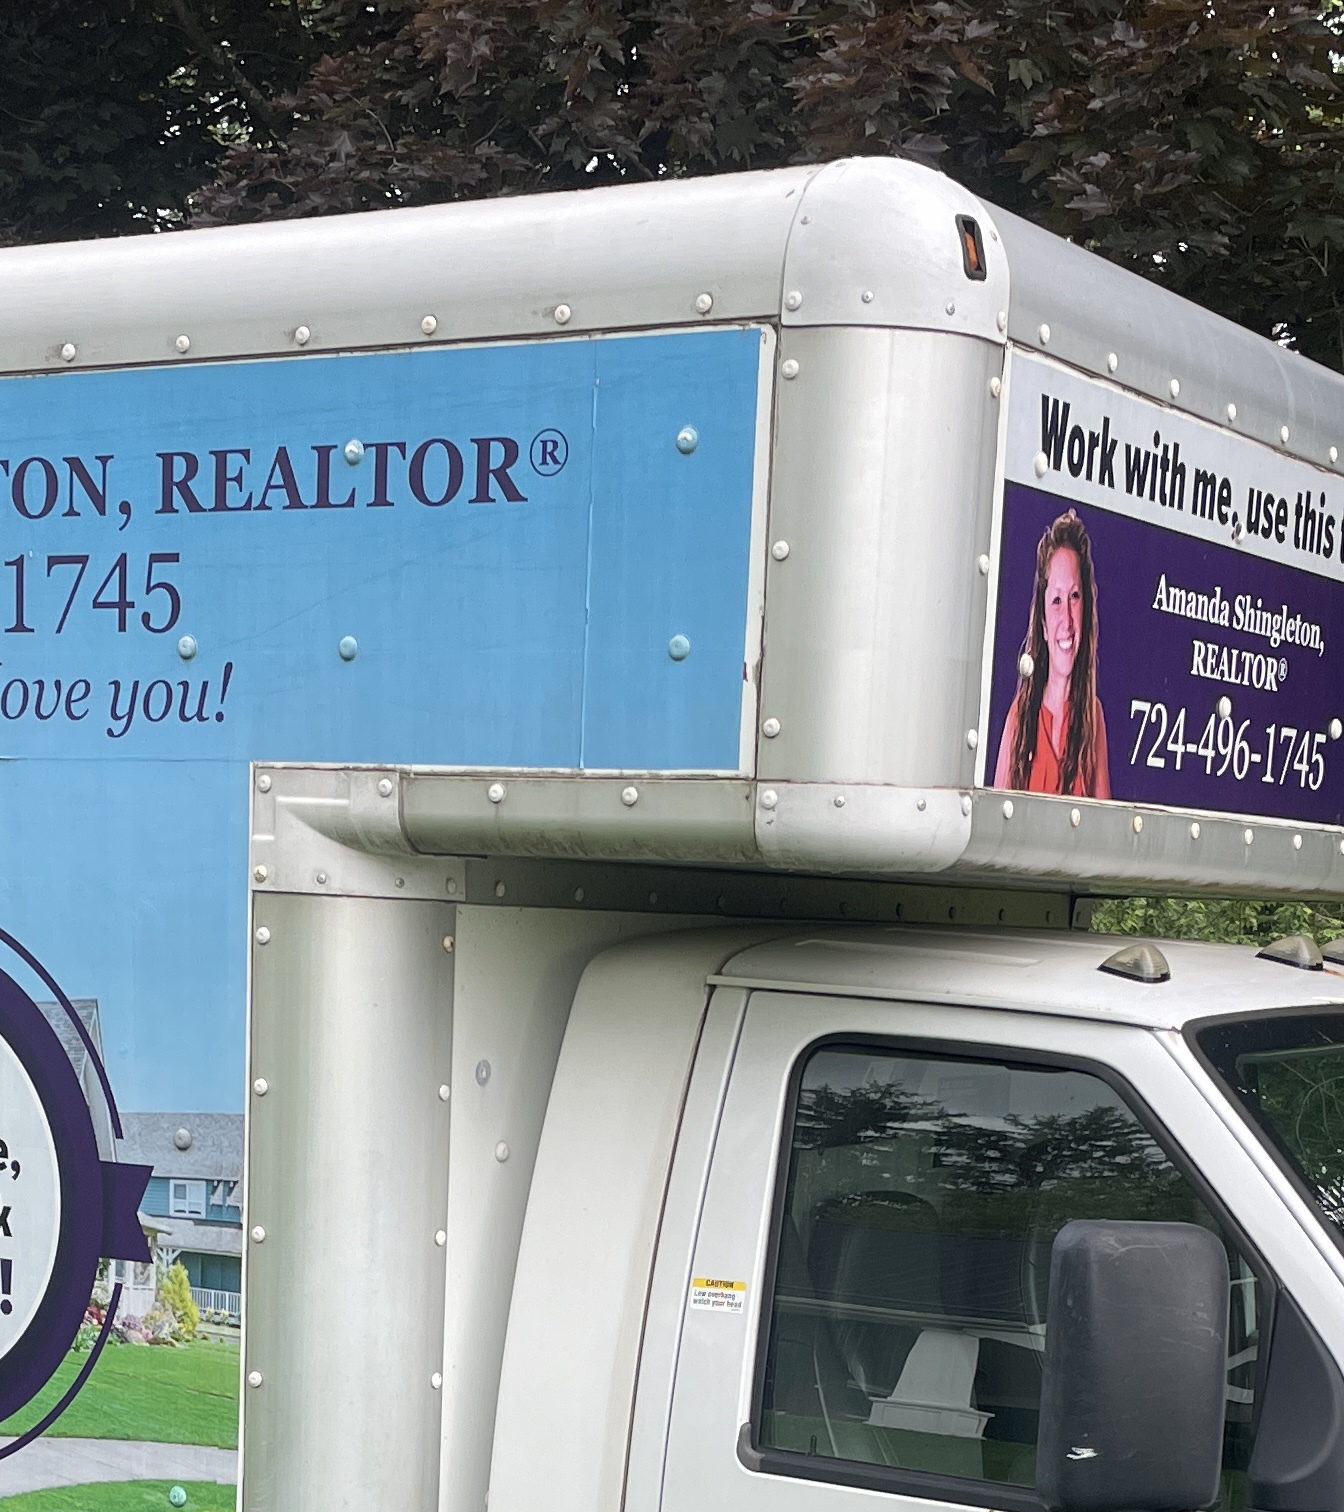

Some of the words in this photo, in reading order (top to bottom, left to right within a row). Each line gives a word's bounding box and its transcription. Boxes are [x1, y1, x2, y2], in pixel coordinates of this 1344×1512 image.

[155, 427, 570, 515] REALTOR®
[1040, 394, 1117, 489] Work
[1124, 430, 1186, 507] with
[1191, 467, 1241, 535] me,
[1246, 487, 1288, 543] use
[1293, 490, 1335, 559] this
[1152, 573, 1230, 628] Amanda
[1232, 599, 1325, 657] Shingleton,
[107, 659, 235, 739] you!
[1130, 700, 1328, 791] 724-496-1745
[706, 1279, 734, 1288] CAUTION
